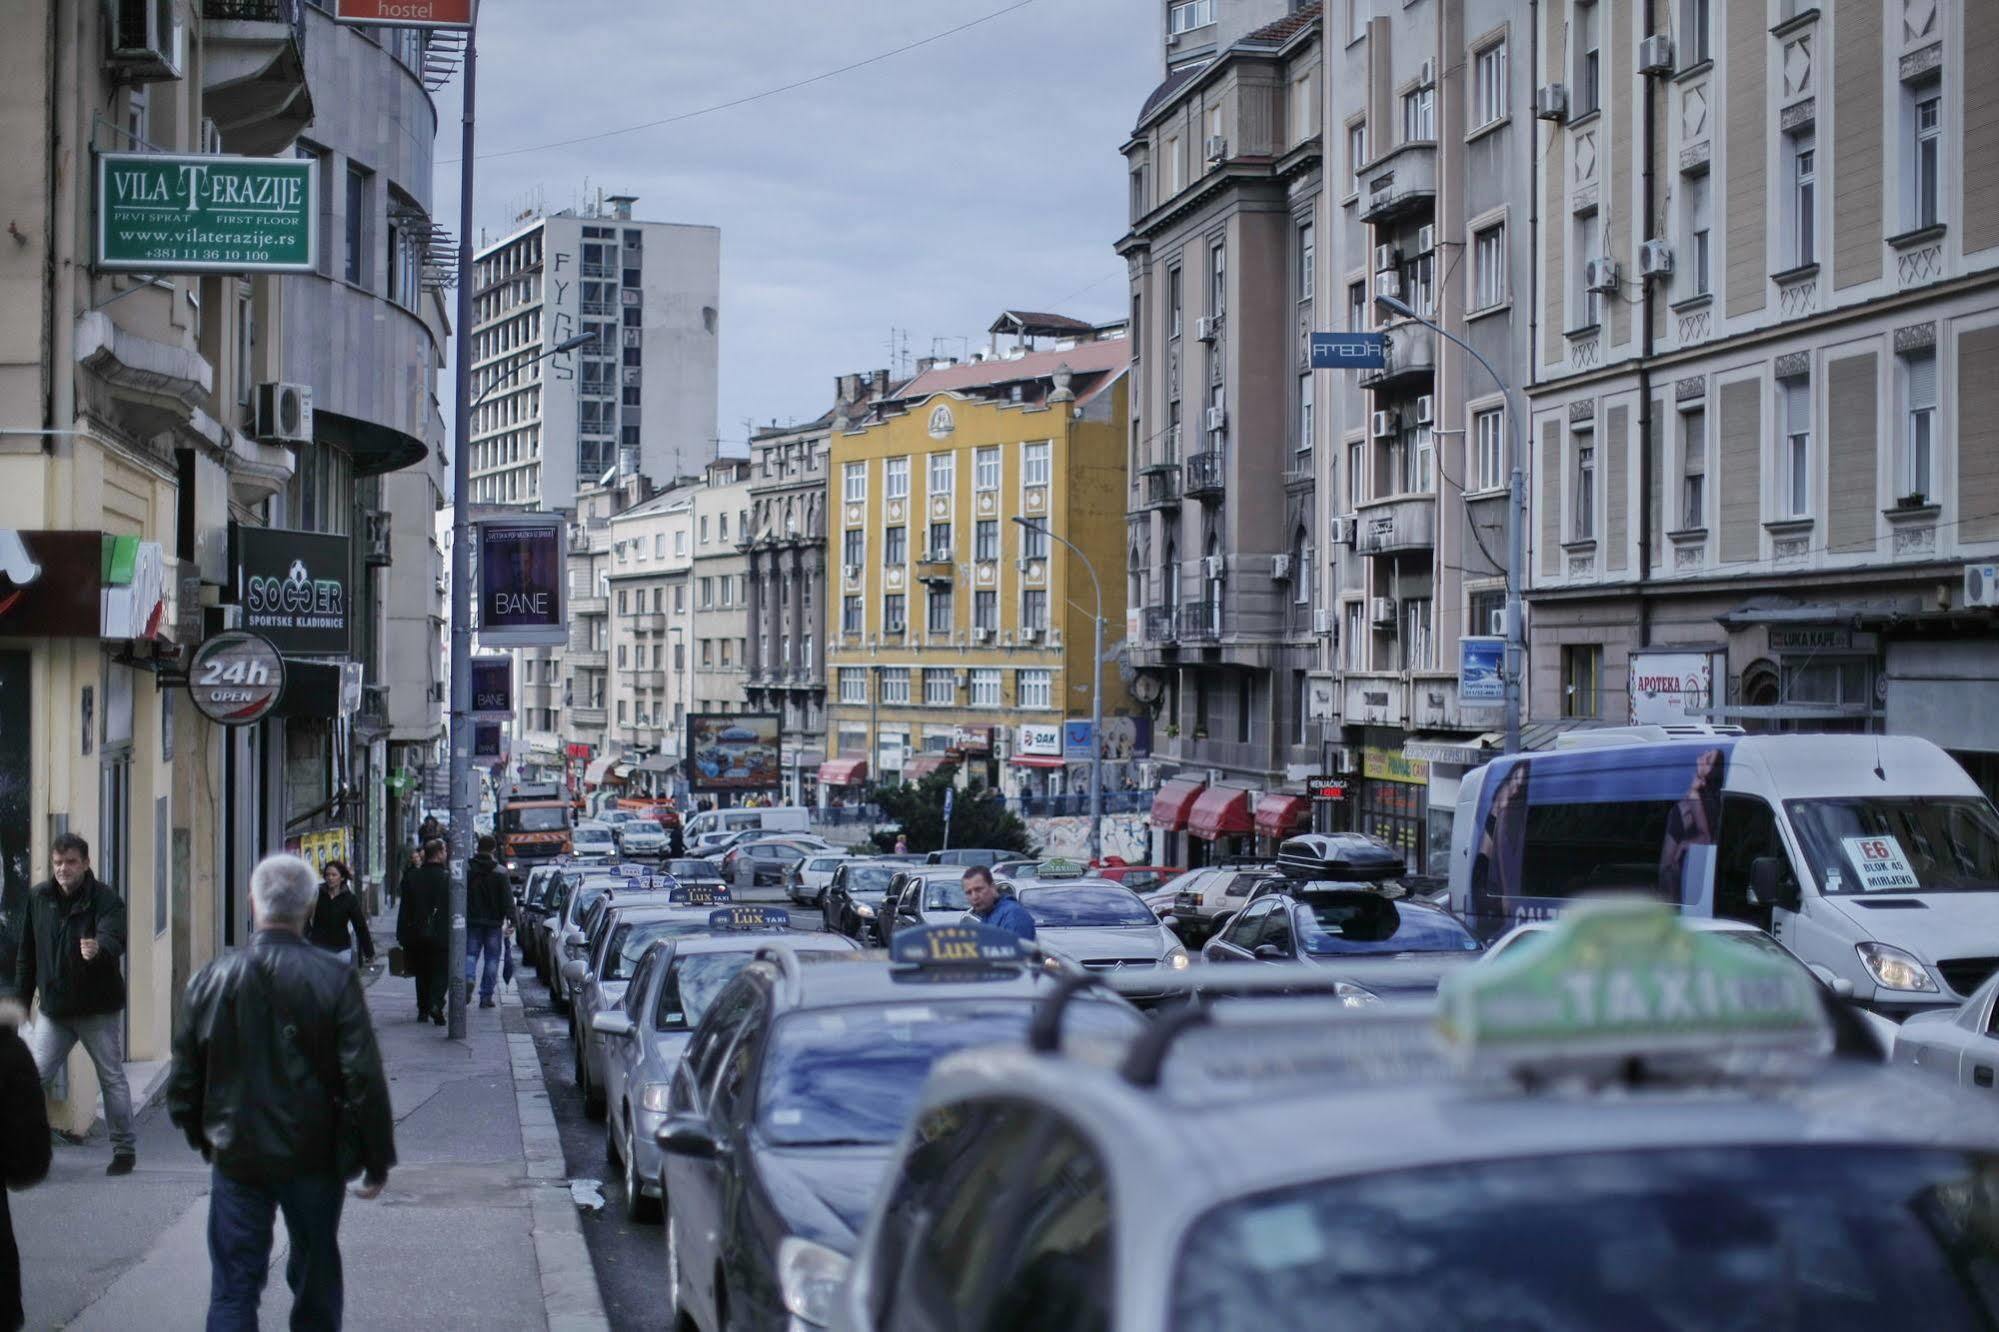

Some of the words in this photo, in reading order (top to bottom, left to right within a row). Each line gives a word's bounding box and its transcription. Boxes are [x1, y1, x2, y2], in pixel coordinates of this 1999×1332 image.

[378, 1, 433, 18] hostel
[114, 172, 169, 200] VILA
[177, 165, 301, 212] TERAZIJE
[114, 212, 148, 222] PRVI
[150, 213, 192, 223] SPRAT
[216, 215, 252, 224] FIRST
[256, 216, 299, 225] FLOOR
[120, 228, 296, 248] www.vilaterazije.rs
[145, 249, 177, 259] +381
[184, 249, 198, 259] 11
[203, 250, 219, 260] 36
[246, 251, 268, 261] 100
[248, 575, 343, 615] SOCCER
[496, 592, 548, 614] BANE
[250, 616, 293, 628] SPORTSKE
[296, 616, 344, 629] KLADIONICE
[199, 660, 269, 686] 24h
[1637, 675, 1680, 693] APOTEKA
[210, 690, 252, 702] OPEN
[477, 693, 504, 706] BANE
[1860, 840, 1890, 859] E6
[1863, 862, 1888, 872] BLOK
[1891, 861, 1904, 871] 45
[1867, 875, 1913, 887] MIRIJEVO
[981, 946, 1016, 957] TAXI
[1561, 966, 1722, 1027] TAXI
